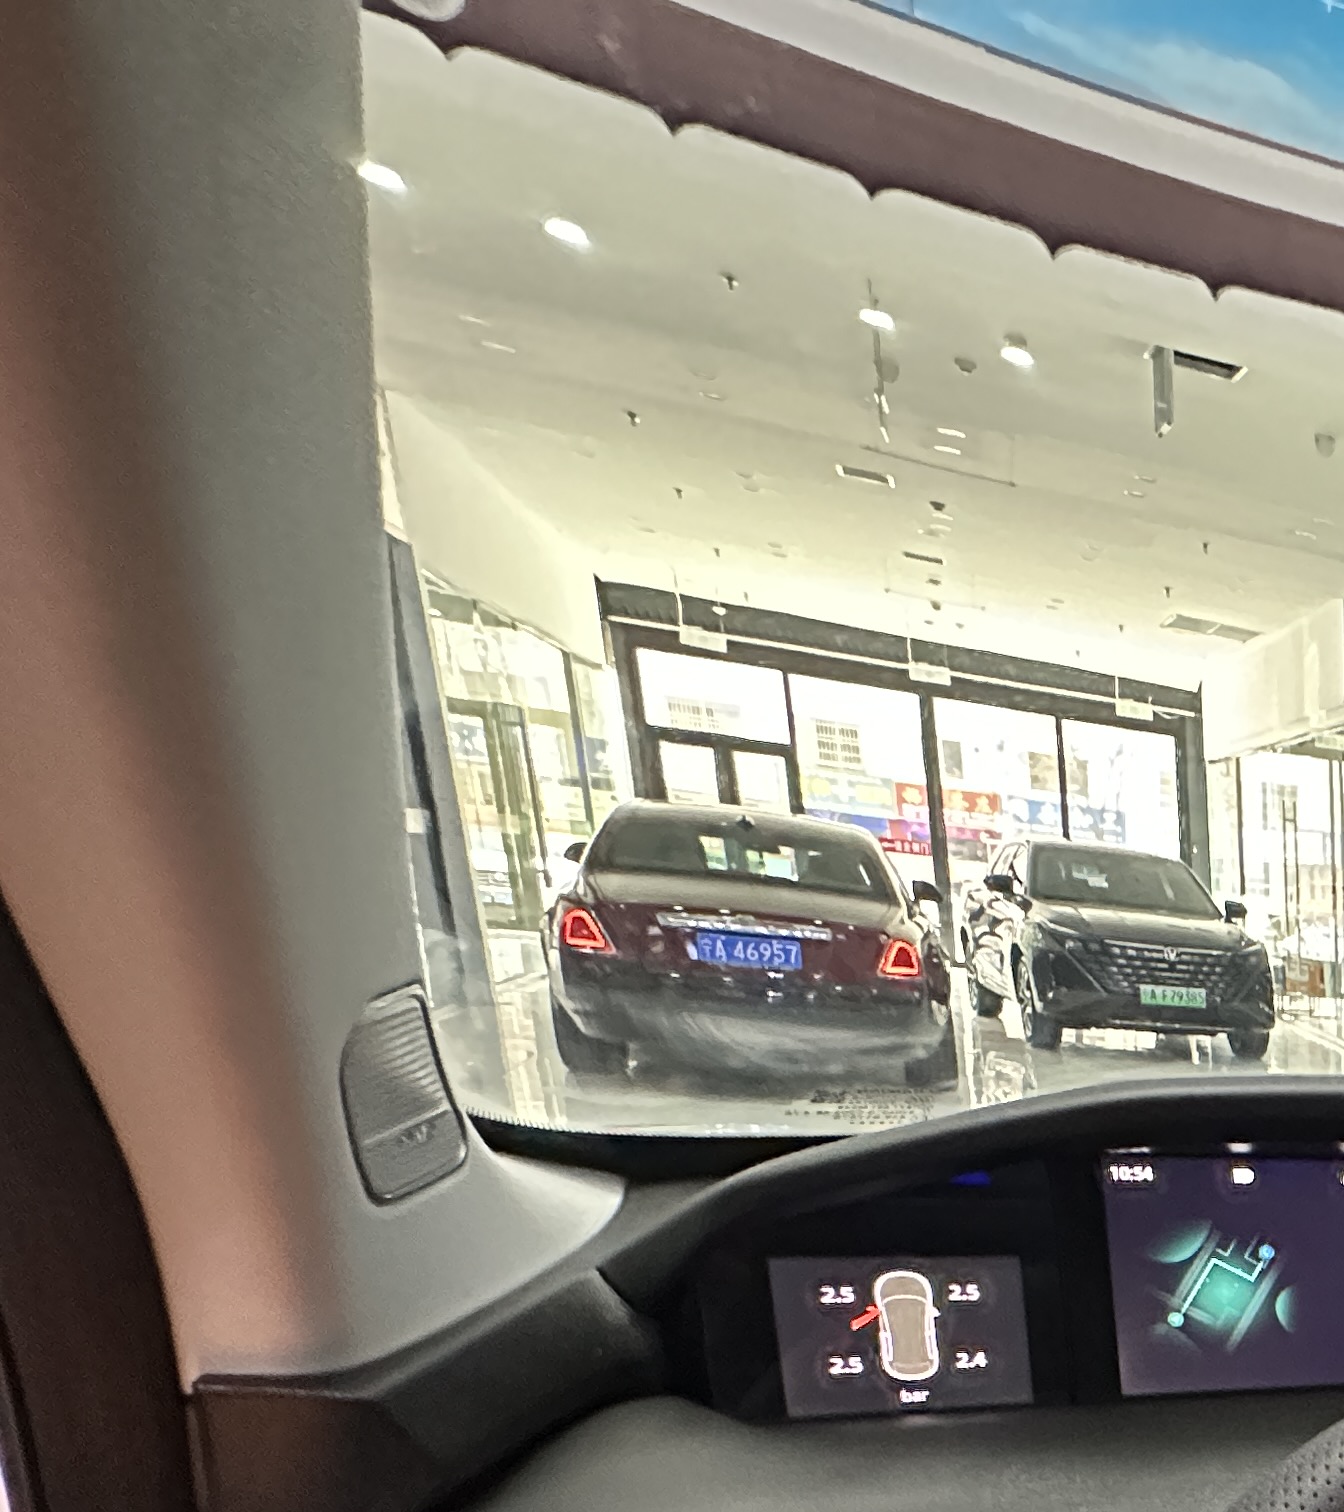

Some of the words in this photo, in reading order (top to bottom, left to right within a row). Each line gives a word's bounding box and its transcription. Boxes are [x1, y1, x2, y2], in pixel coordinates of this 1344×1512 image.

[733, 940, 798, 966] 46957
[1109, 1164, 1154, 1182] 10:54
[819, 1284, 856, 1305] 2.5
[948, 1283, 981, 1302] 2.5
[828, 1354, 864, 1375] 2.5
[955, 1350, 988, 1370] 2.4
[900, 1387, 930, 1403] bar
